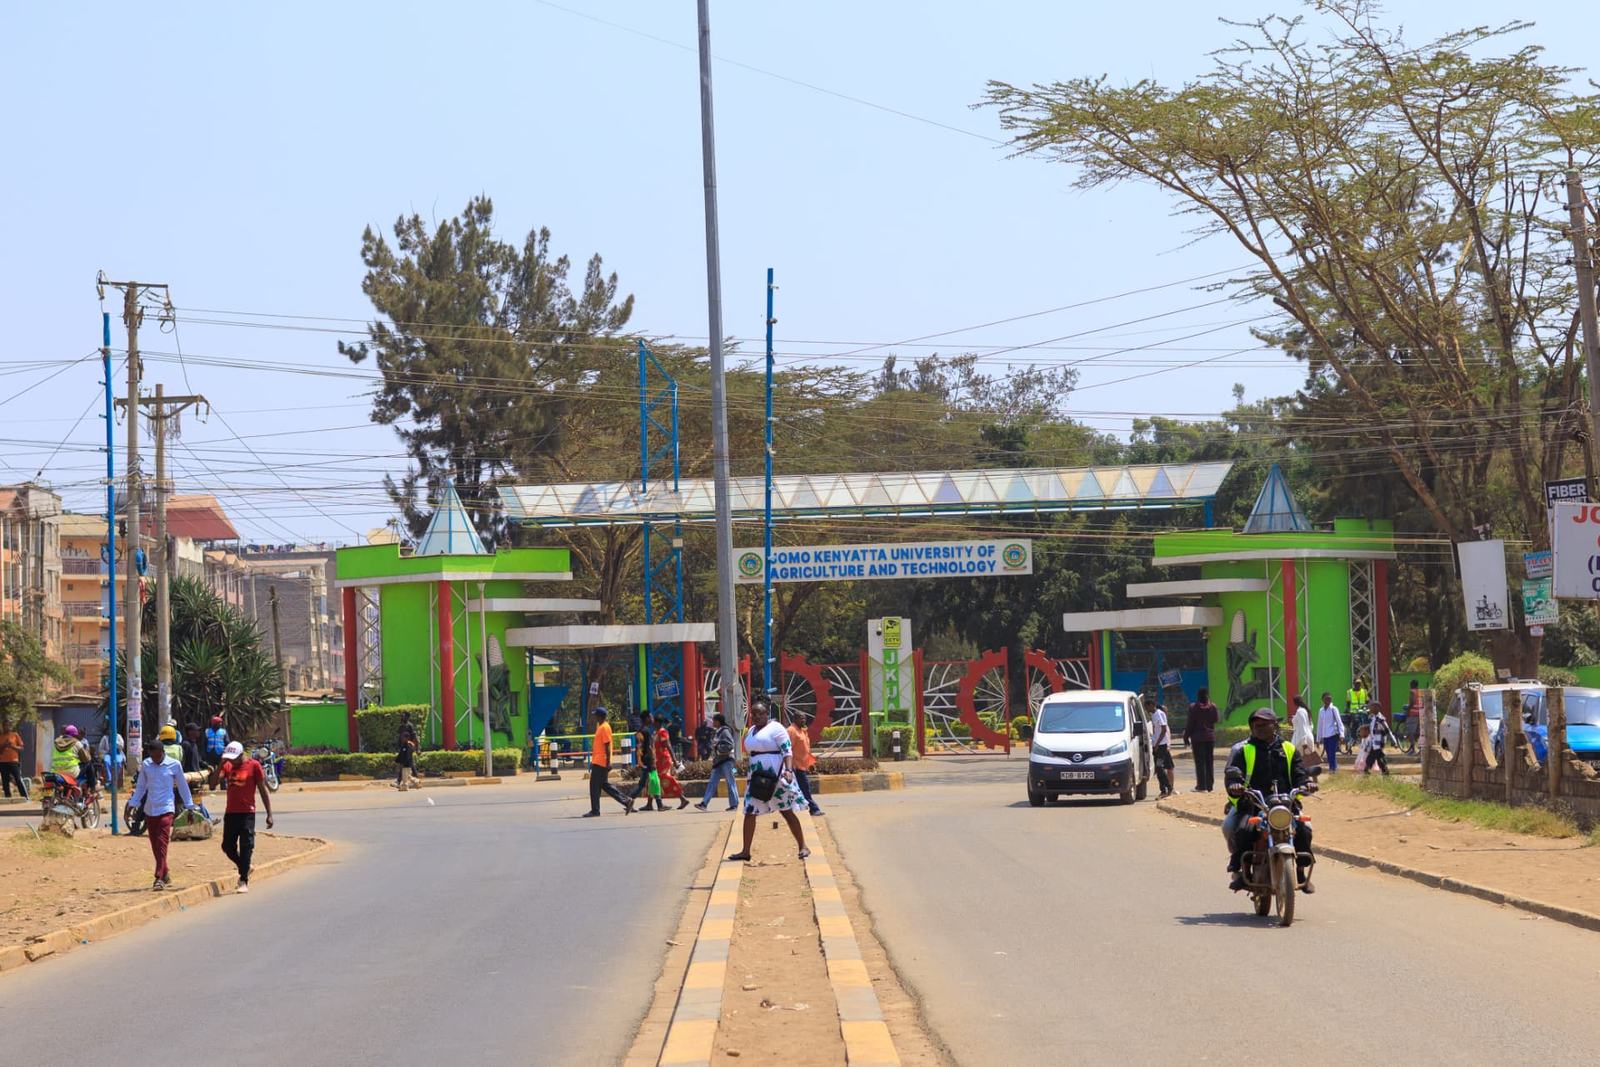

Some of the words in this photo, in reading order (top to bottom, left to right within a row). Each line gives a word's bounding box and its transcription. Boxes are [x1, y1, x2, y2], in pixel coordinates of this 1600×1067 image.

[1548, 484, 1586, 498] FIBER
[814, 549, 887, 563] KENYATTA
[891, 546, 973, 561] UNIVERSITY
[977, 545, 995, 558] OF
[770, 565, 864, 580] AGRICULTURE
[869, 563, 897, 577] AND
[901, 560, 996, 576] TECHNOLOGY
